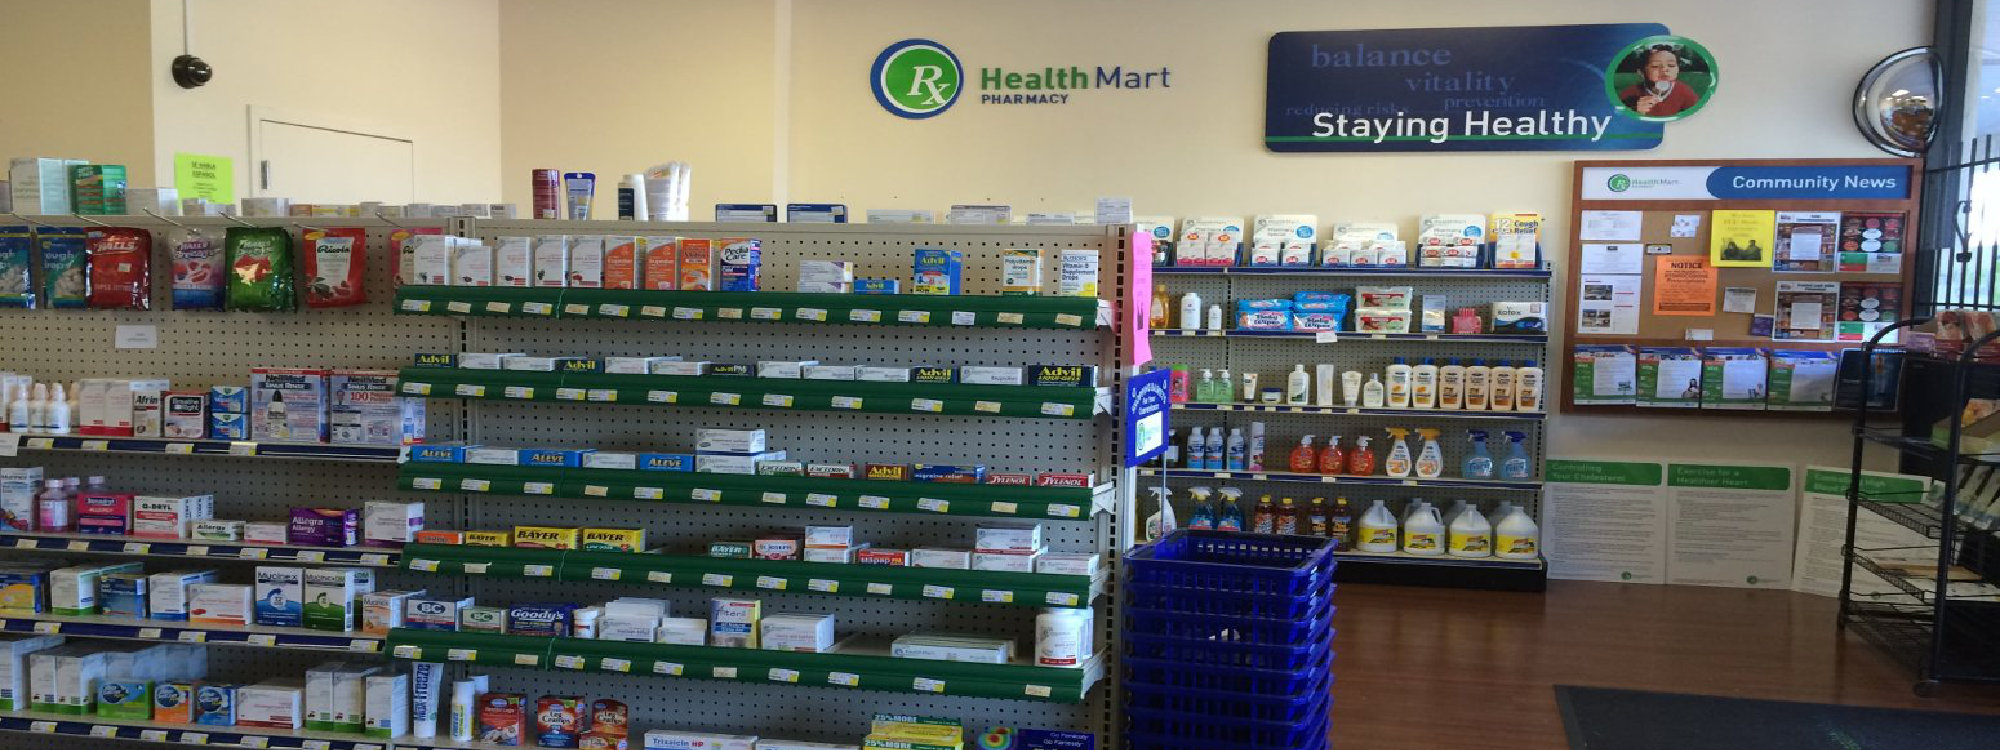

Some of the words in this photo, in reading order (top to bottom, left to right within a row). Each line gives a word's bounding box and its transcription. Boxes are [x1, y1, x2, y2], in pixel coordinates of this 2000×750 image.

[1311, 43, 1452, 69] balance
[981, 66, 1089, 91] Health
[1095, 66, 1170, 90] Mart
[1405, 71, 1516, 95] vitality
[981, 94, 1069, 105] PHARMACY
[1444, 93, 1545, 112] prevention
[1312, 111, 1450, 143] Staying
[1464, 109, 1613, 142] Healthy
[1732, 175, 1839, 192] Community
[1844, 175, 1897, 189] News
[317, 245, 350, 255] Ricola
[564, 360, 596, 372] Advil
[917, 366, 951, 377] Advil
[1040, 366, 1082, 377] Advil
[265, 374, 306, 383] NeilMed
[347, 376, 387, 384] NeilMed
[135, 395, 158, 405] Afrin
[421, 449, 454, 458] ALEVE
[532, 453, 565, 464] ALEVE
[648, 457, 682, 468] ALEVE
[870, 465, 902, 476] Advil
[292, 516, 324, 526] Allegra
[516, 530, 560, 540] BAYER
[586, 533, 625, 542] BAYER
[258, 572, 298, 580] Mucinex
[422, 603, 442, 614] BC
[511, 609, 564, 622] Goody's
